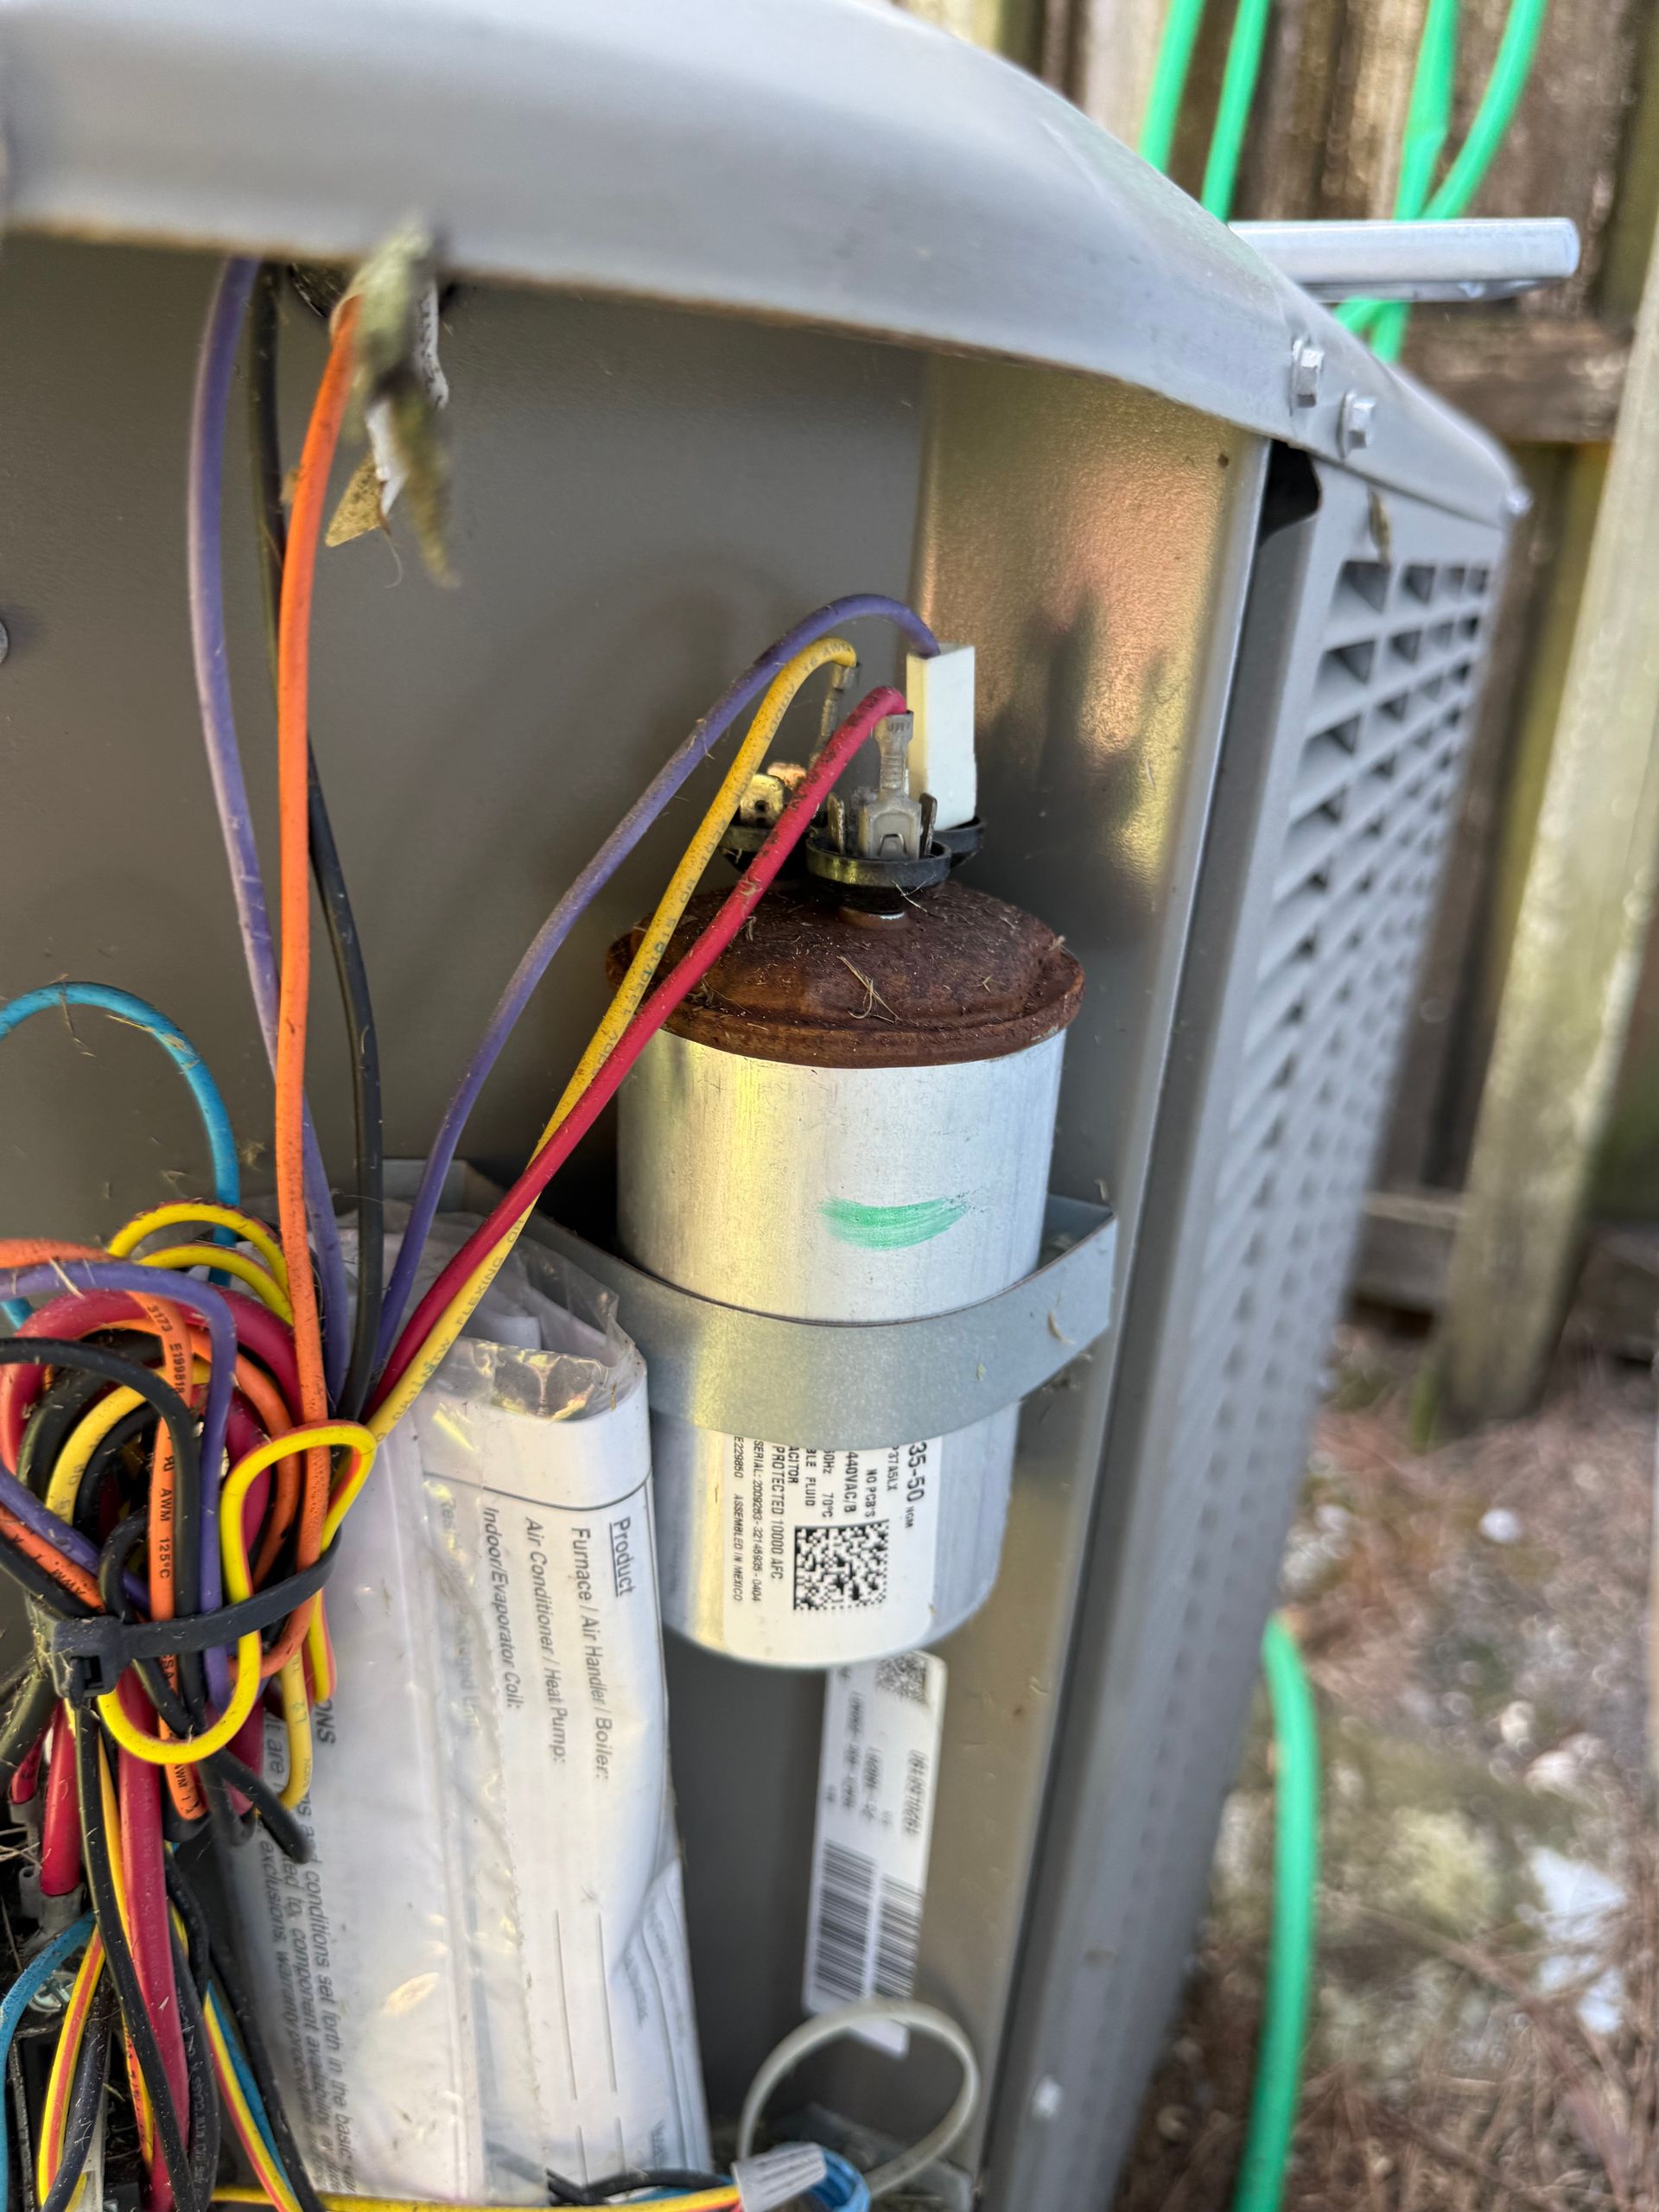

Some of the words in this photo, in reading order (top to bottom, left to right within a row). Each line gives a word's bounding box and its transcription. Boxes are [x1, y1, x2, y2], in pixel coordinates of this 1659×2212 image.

[148, 1305, 174, 1332] 3173
[753, 1440, 764, 1477] SERIAL:
[866, 1469, 877, 1483] NO
[906, 1443, 927, 1502] 35-50
[771, 1446, 785, 1515] PROTECTED
[805, 1477, 816, 1506] FLUID
[842, 1452, 858, 1513] 440VAC/B
[160, 1488, 173, 1522] AWM
[734, 1494, 743, 1549] ASSEMBLED
[526, 1516, 544, 1546] Air
[771, 1519, 784, 1554] 10000
[571, 1527, 594, 1600] Furnace
[612, 1516, 636, 1597] Product
[734, 1552, 743, 1561] IN
[771, 1558, 783, 1580] AFC
[734, 1565, 743, 1601] MEXICO
[483, 1507, 516, 1668] Indoor/Evaporator
[504, 1672, 524, 1709] Coil:
[529, 1551, 556, 1654] Conditioner
[580, 1615, 599, 1640] Air
[543, 1668, 565, 1703] Heat
[584, 1645, 608, 1705] Handler
[549, 1707, 569, 1763] Pump:
[594, 1716, 613, 1781] Boiler:
[267, 1738, 287, 1775] are
[304, 1871, 335, 1967] conditions
[290, 1927, 318, 2032] component
[316, 1974, 340, 2005] set
[329, 2079, 352, 2108] the
